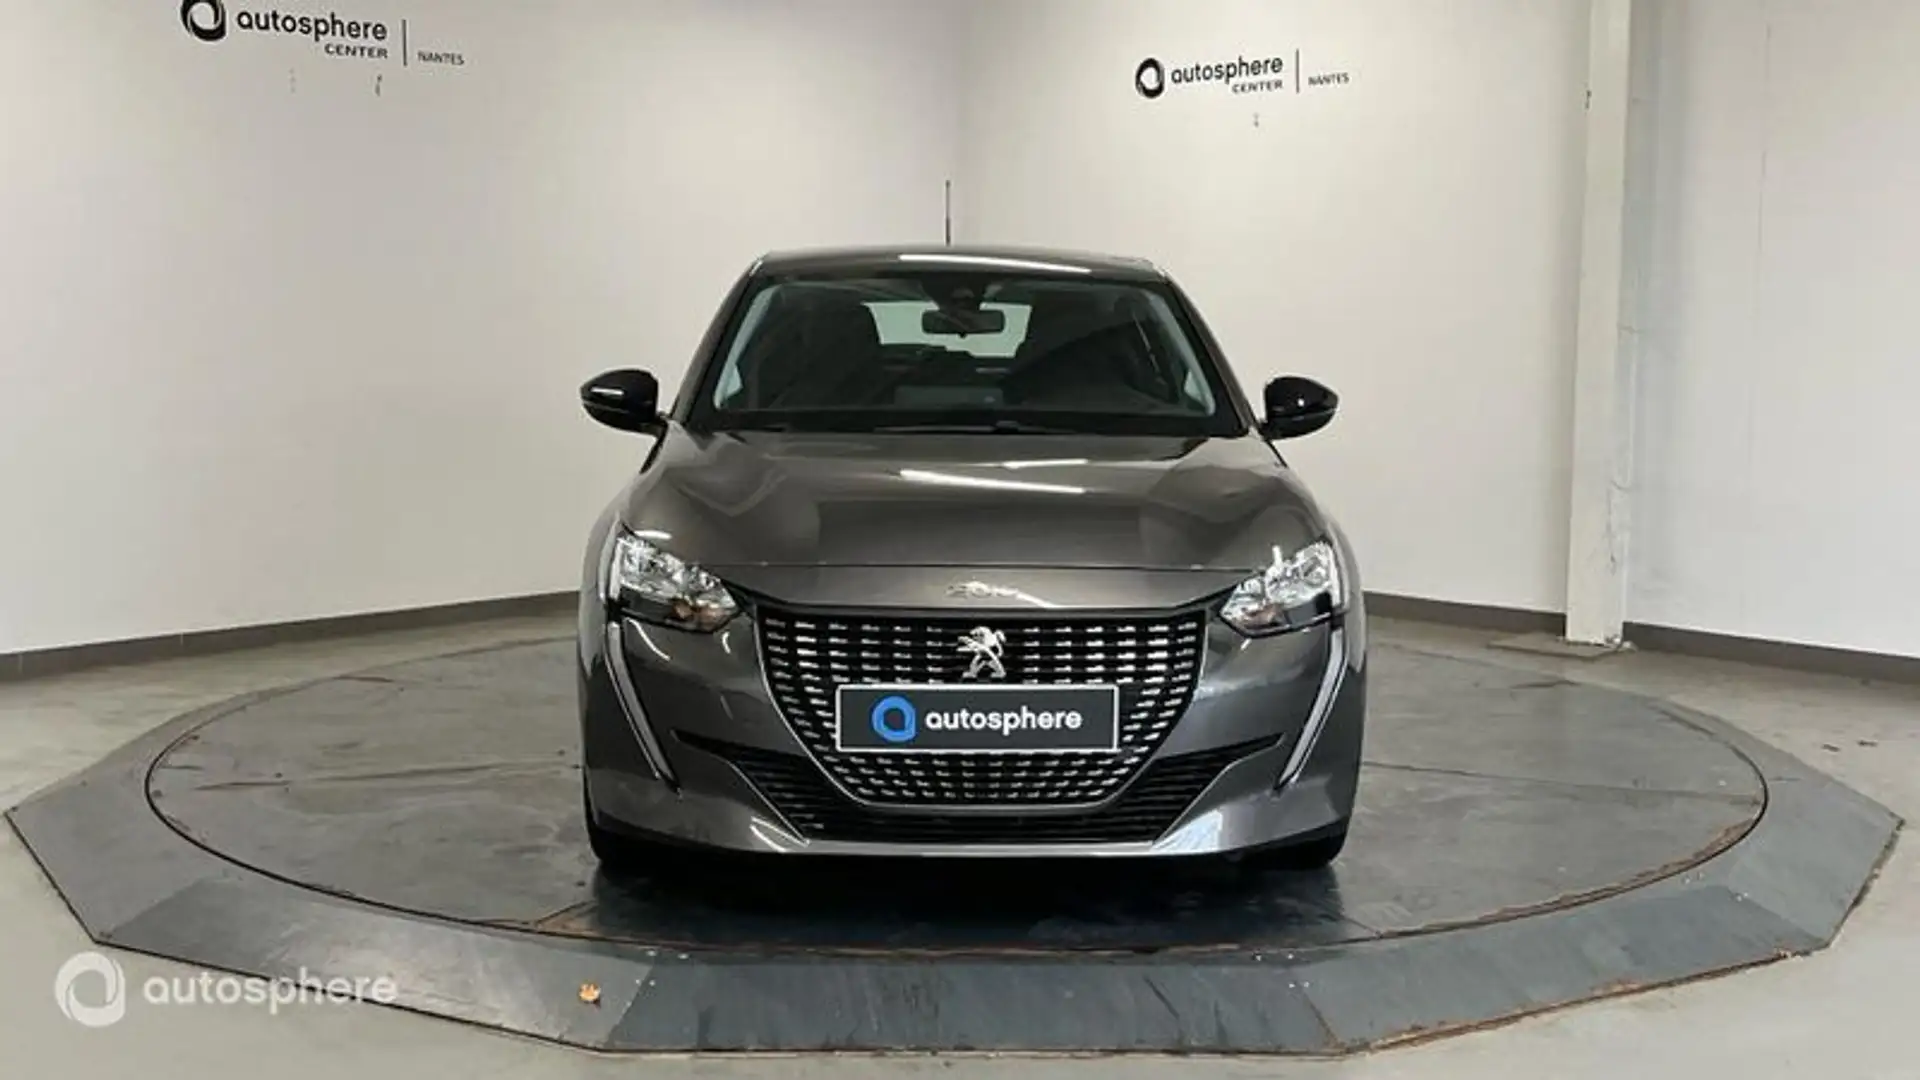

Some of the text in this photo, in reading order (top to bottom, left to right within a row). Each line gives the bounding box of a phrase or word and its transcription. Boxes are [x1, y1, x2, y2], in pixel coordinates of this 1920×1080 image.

[236, 10, 388, 42] autosphere
[324, 43, 388, 59] CENTER
[417, 50, 465, 66] NANTES
[1171, 55, 1284, 85] autosphere
[1231, 79, 1284, 94] CENTER
[1307, 72, 1350, 87] NANTES
[924, 705, 1083, 736] autosphere
